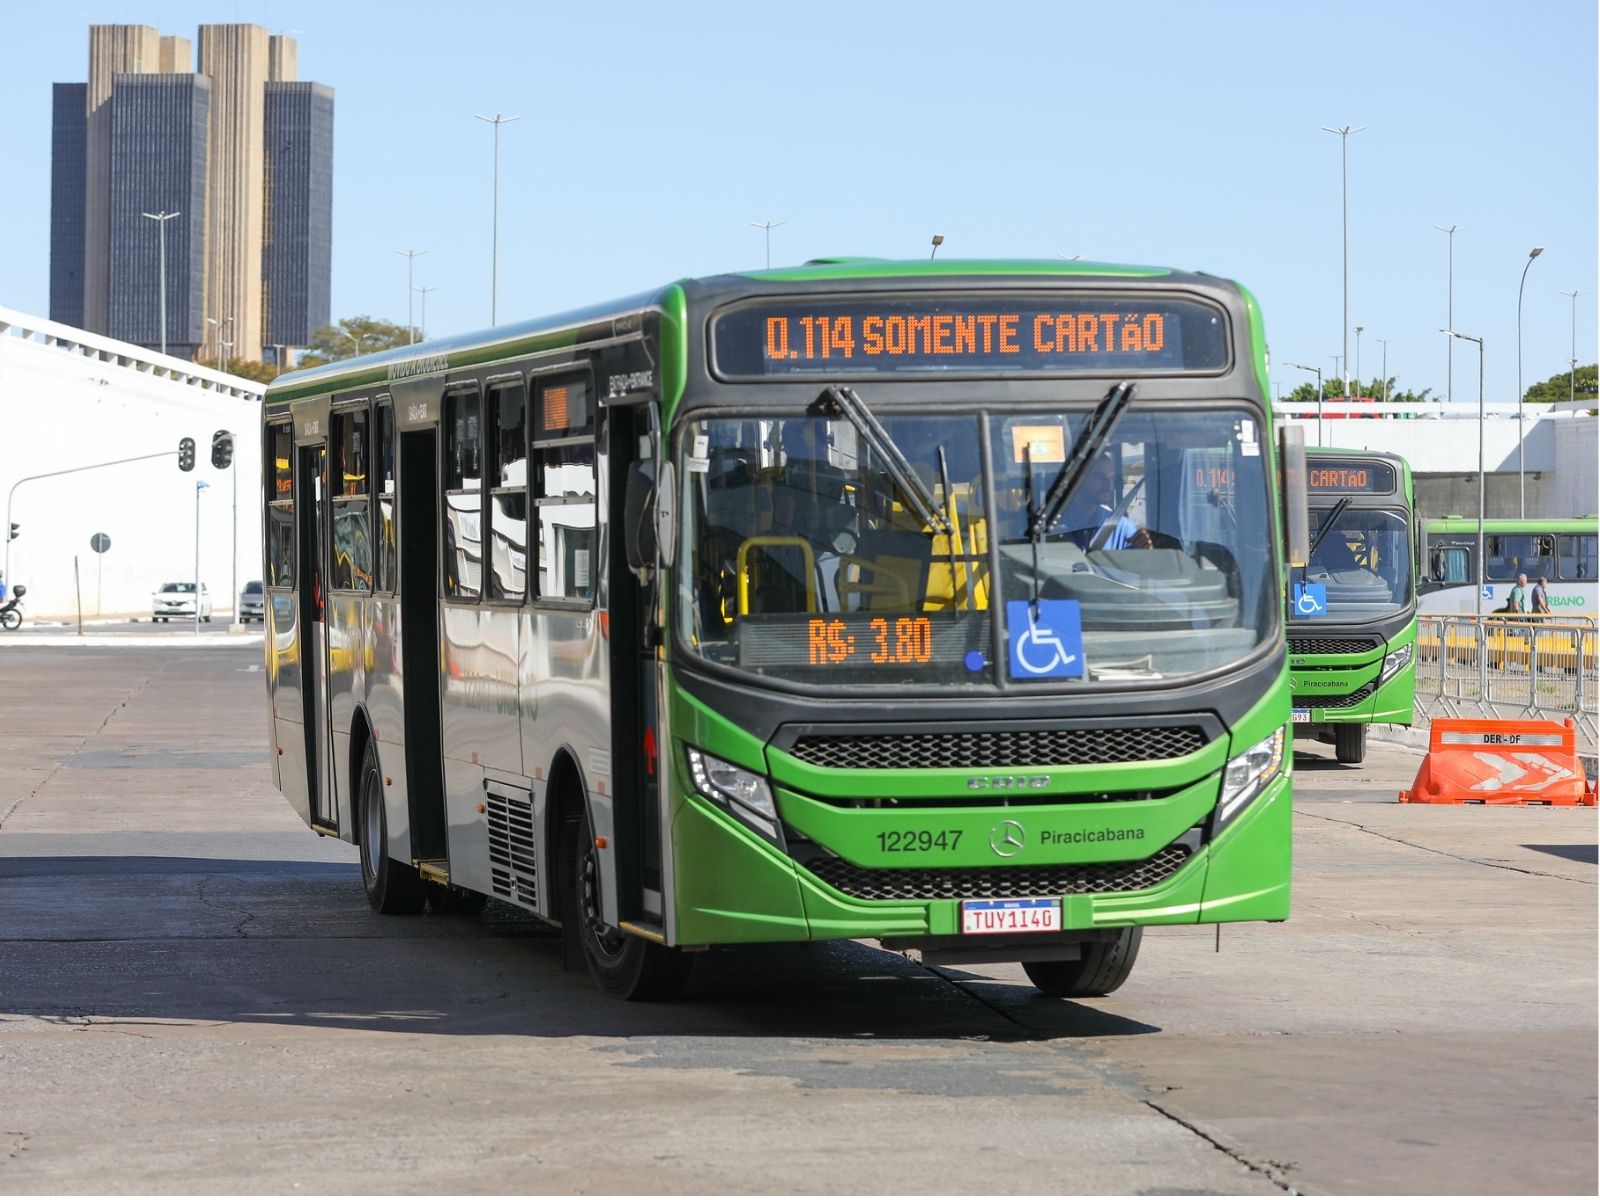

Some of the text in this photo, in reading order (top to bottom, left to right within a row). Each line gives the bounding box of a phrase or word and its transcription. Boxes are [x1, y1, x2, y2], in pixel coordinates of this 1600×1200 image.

[766, 315, 855, 360] 0.114
[862, 313, 1020, 356] SOMENTE
[1546, 596, 1585, 607] RBANO
[870, 617, 931, 663] 3.80
[1483, 734, 1502, 744] DER
[876, 830, 963, 852] 122947
[1040, 825, 1145, 845] Piracicabana
[973, 909, 1051, 929] TUY1I40
